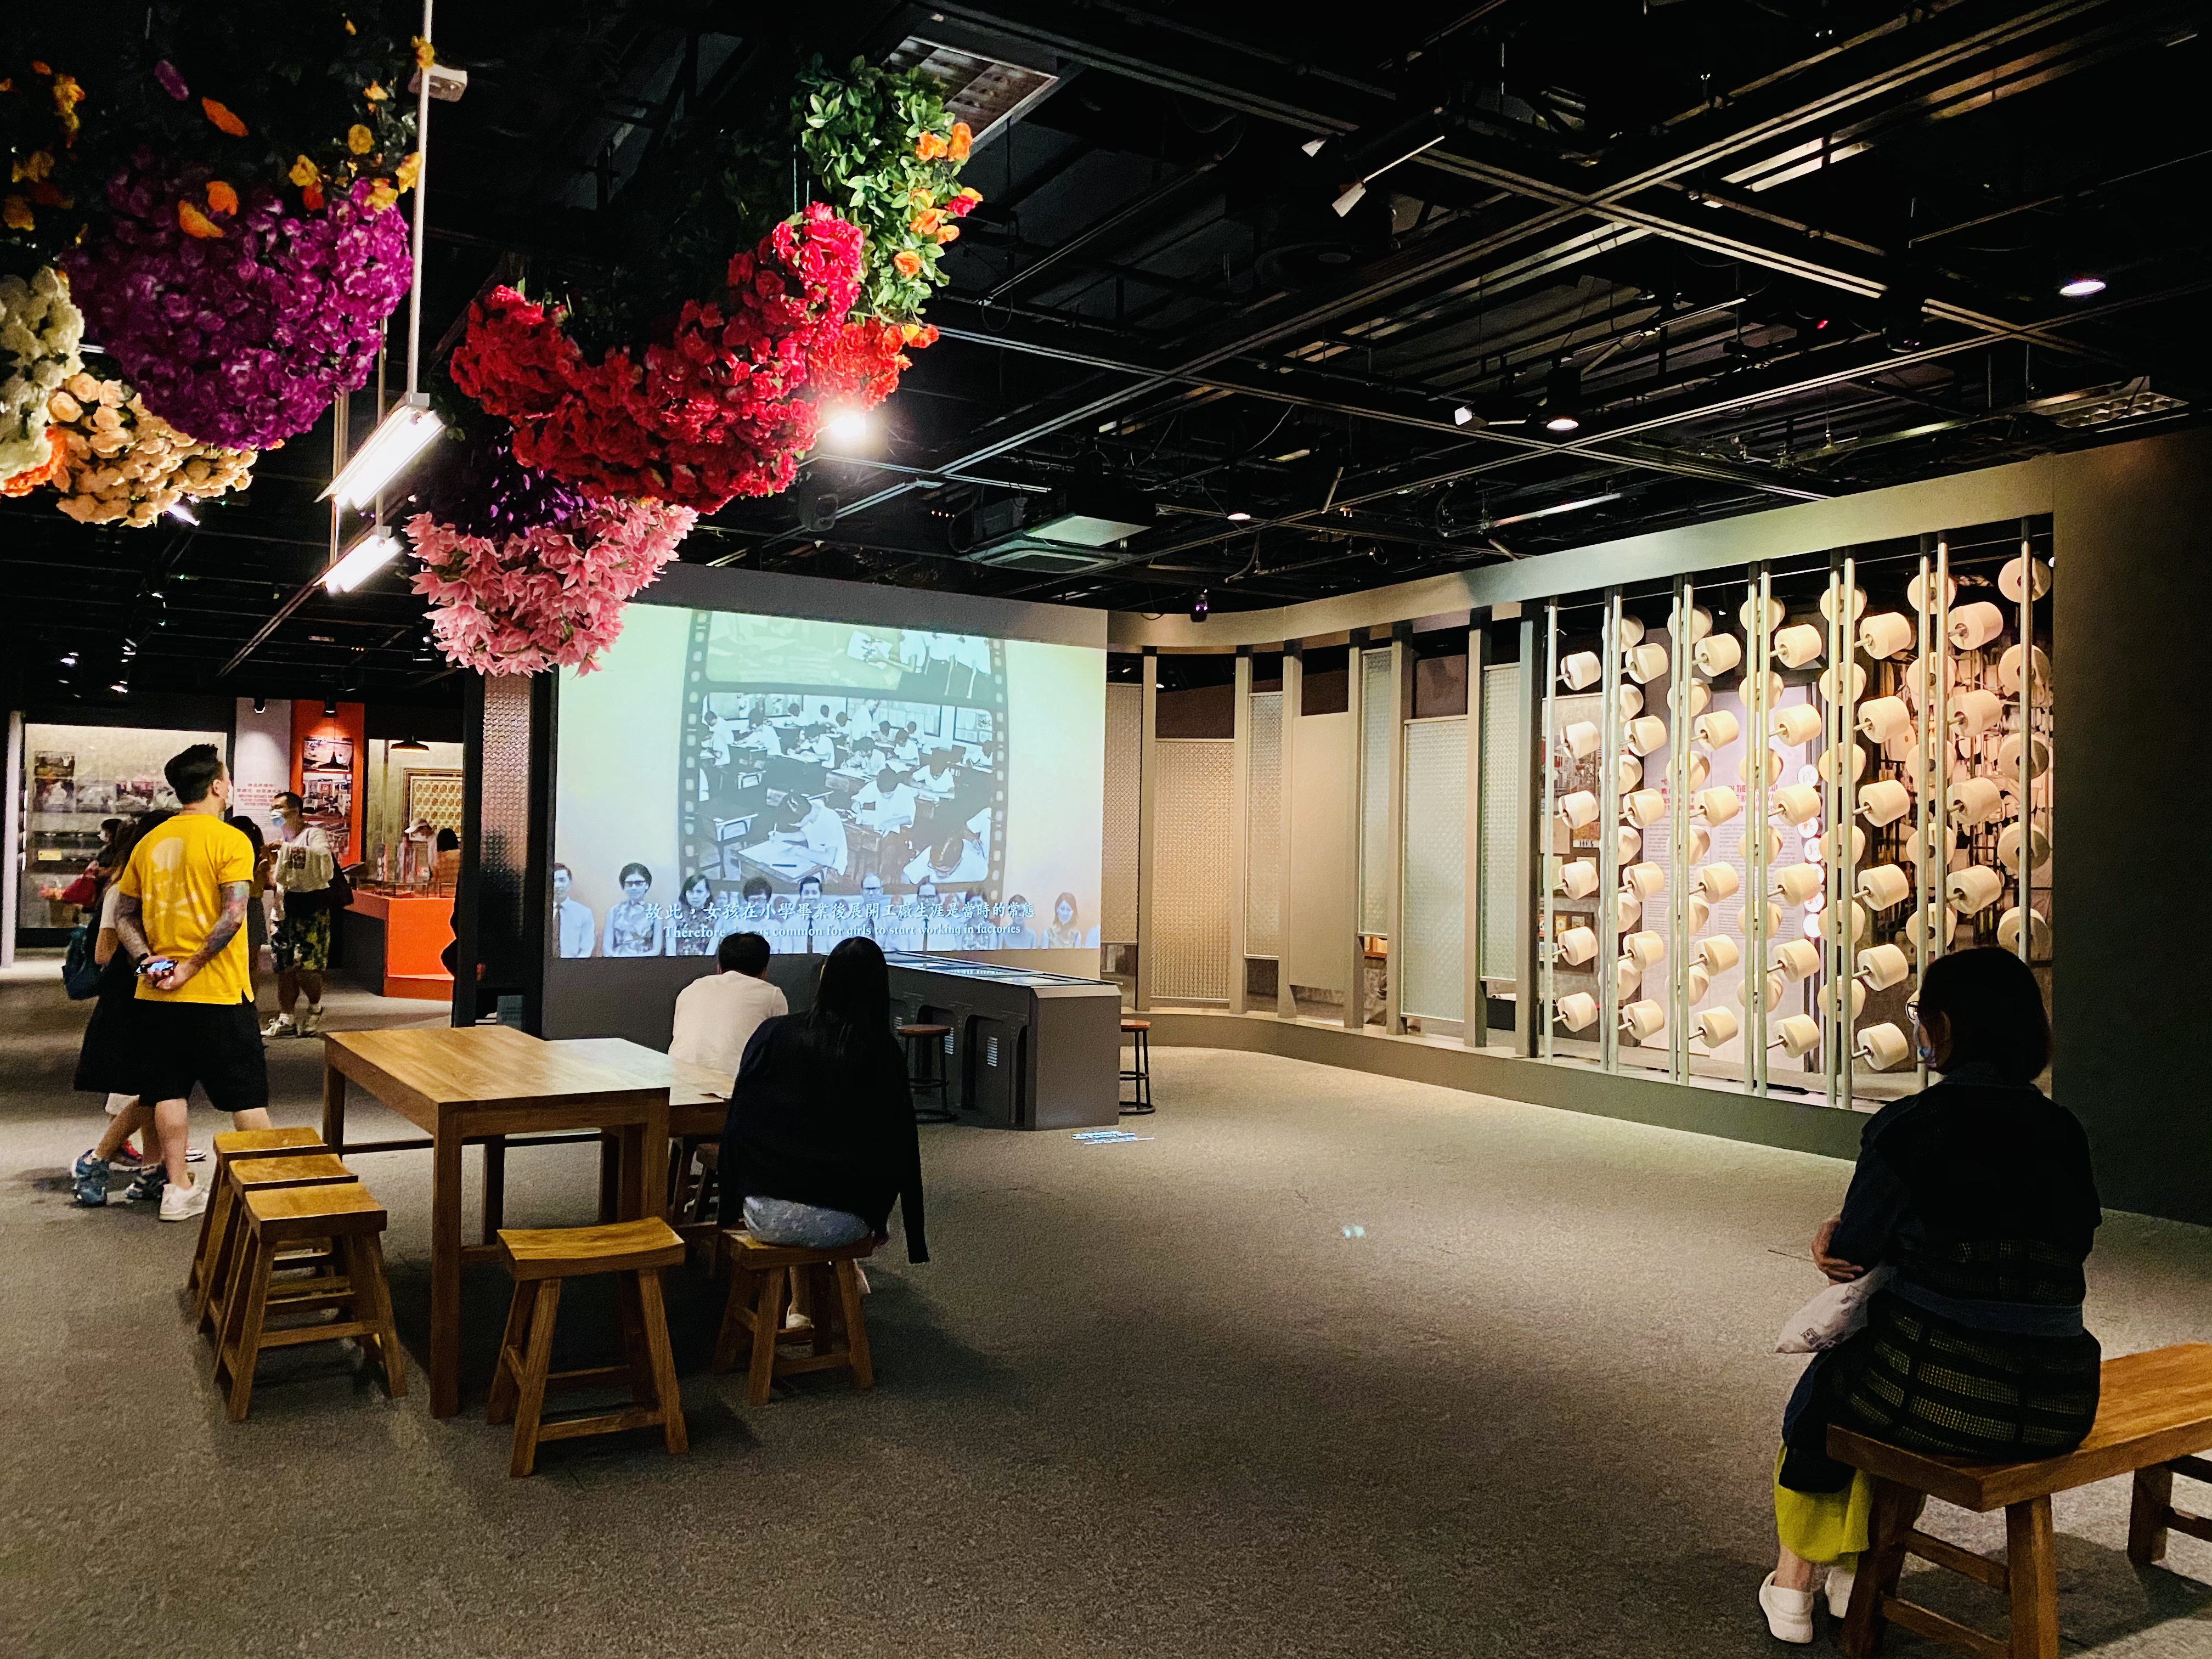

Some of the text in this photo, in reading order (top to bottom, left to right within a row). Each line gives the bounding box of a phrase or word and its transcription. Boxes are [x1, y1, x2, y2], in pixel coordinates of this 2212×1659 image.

[663, 924, 725, 938] Therefore
[772, 927, 822, 936] common
[827, 924, 844, 936] for
[847, 924, 871, 937] girls
[874, 927, 886, 935] to
[889, 926, 915, 935] start
[918, 924, 961, 936] working
[963, 923, 974, 934] in
[977, 923, 1021, 934] factories
